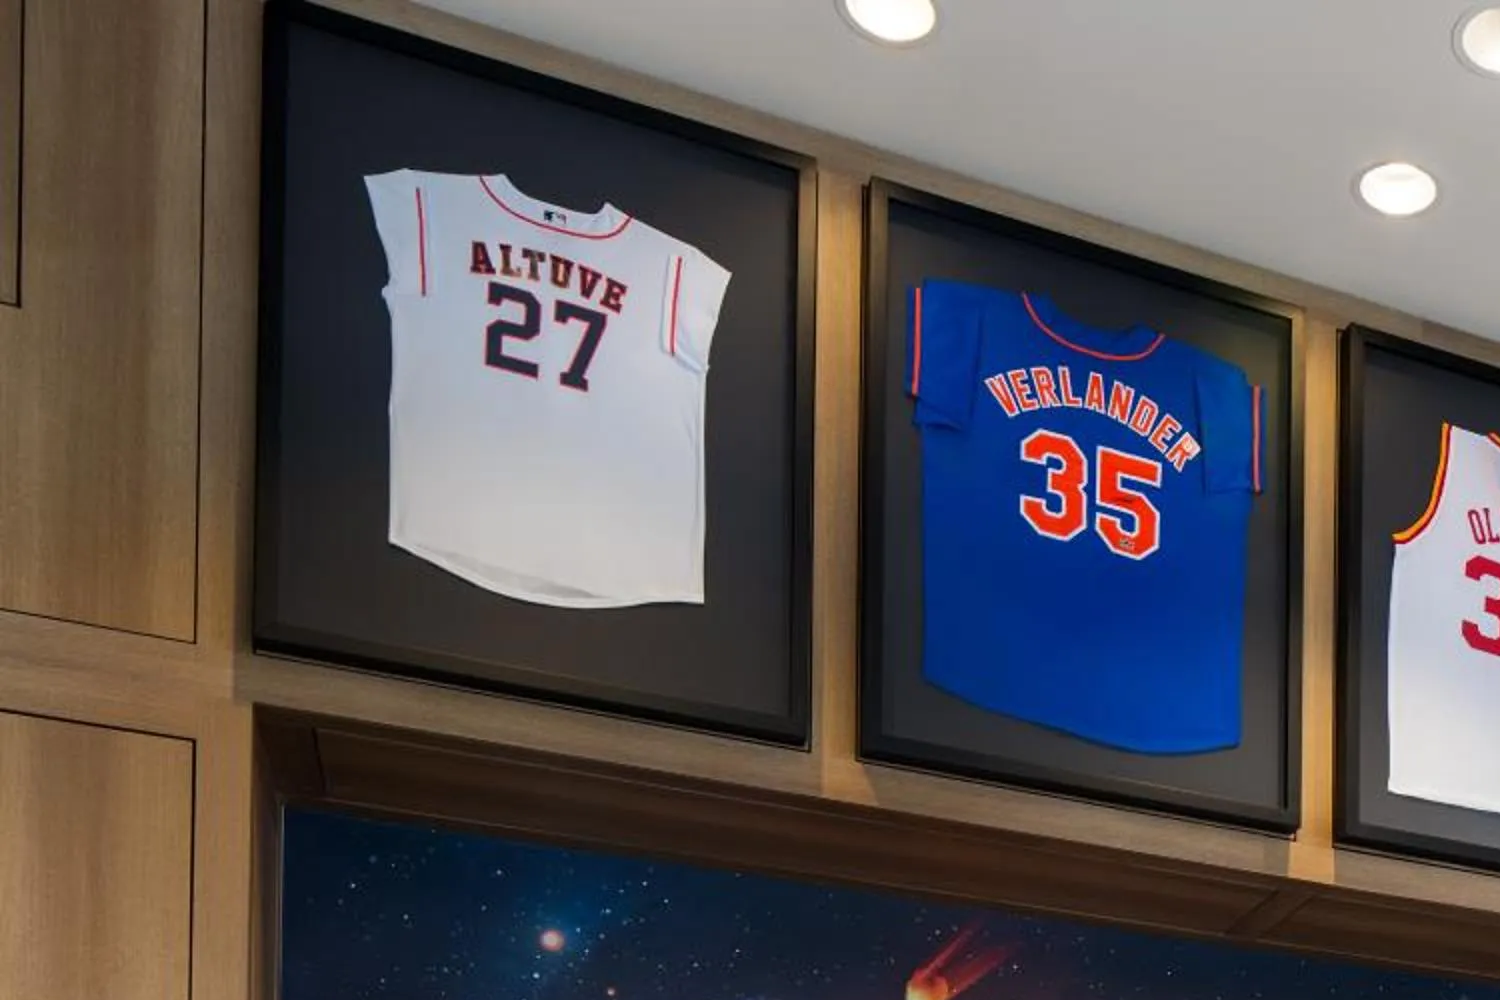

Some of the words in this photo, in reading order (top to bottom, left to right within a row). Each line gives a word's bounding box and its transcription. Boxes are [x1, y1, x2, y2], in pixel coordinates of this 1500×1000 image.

[470, 241, 627, 313] ALTUVE
[485, 282, 607, 392] 27
[985, 365, 1201, 472] VERLANDER
[1020, 429, 1161, 560] 35
